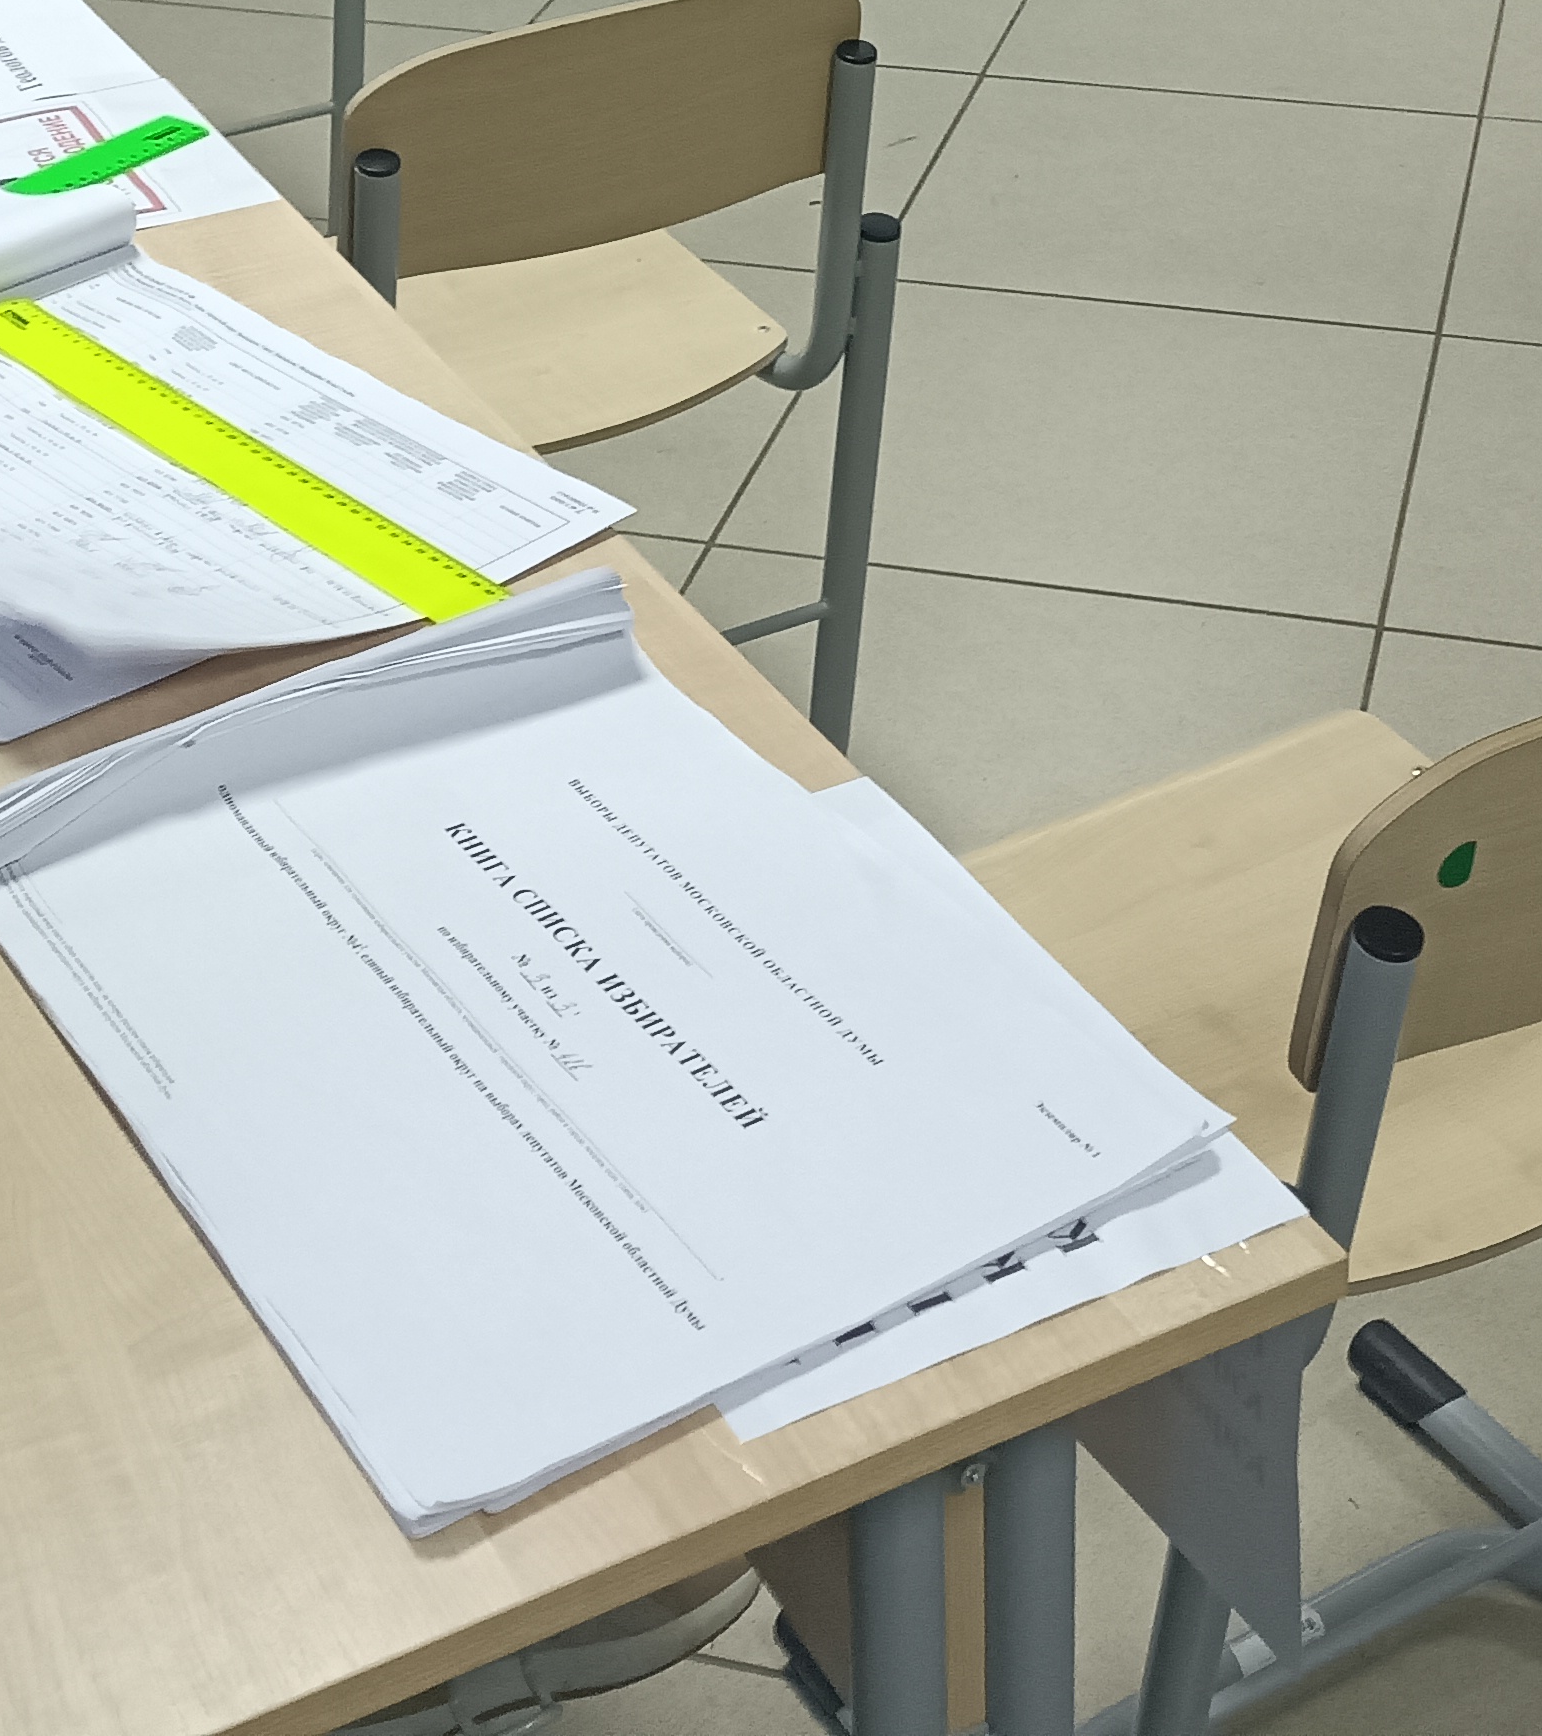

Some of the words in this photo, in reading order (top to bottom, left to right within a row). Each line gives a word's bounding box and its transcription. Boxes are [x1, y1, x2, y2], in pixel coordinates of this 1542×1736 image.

[444, 821, 516, 889] КНИГА
[512, 888, 602, 974] СПИСКА
[596, 972, 770, 1131] ИЗБИРАТЕЛЕЙ
[568, 777, 618, 822] ВЫБОРЫ
[612, 822, 683, 882] ДЕПУТАТОВ
[679, 881, 766, 958] МОСКОВСКОЙ
[762, 957, 844, 1027] ОБЛАСТНОЙ
[836, 1028, 884, 1067] ДУМЫ
[449, 1051, 476, 1078] округ
[484, 1091, 523, 1131] выборах
[518, 1130, 568, 1180] депутатов
[565, 1178, 628, 1243] Московской
[621, 1240, 678, 1299] областной
[669, 1298, 706, 1331] Думы
